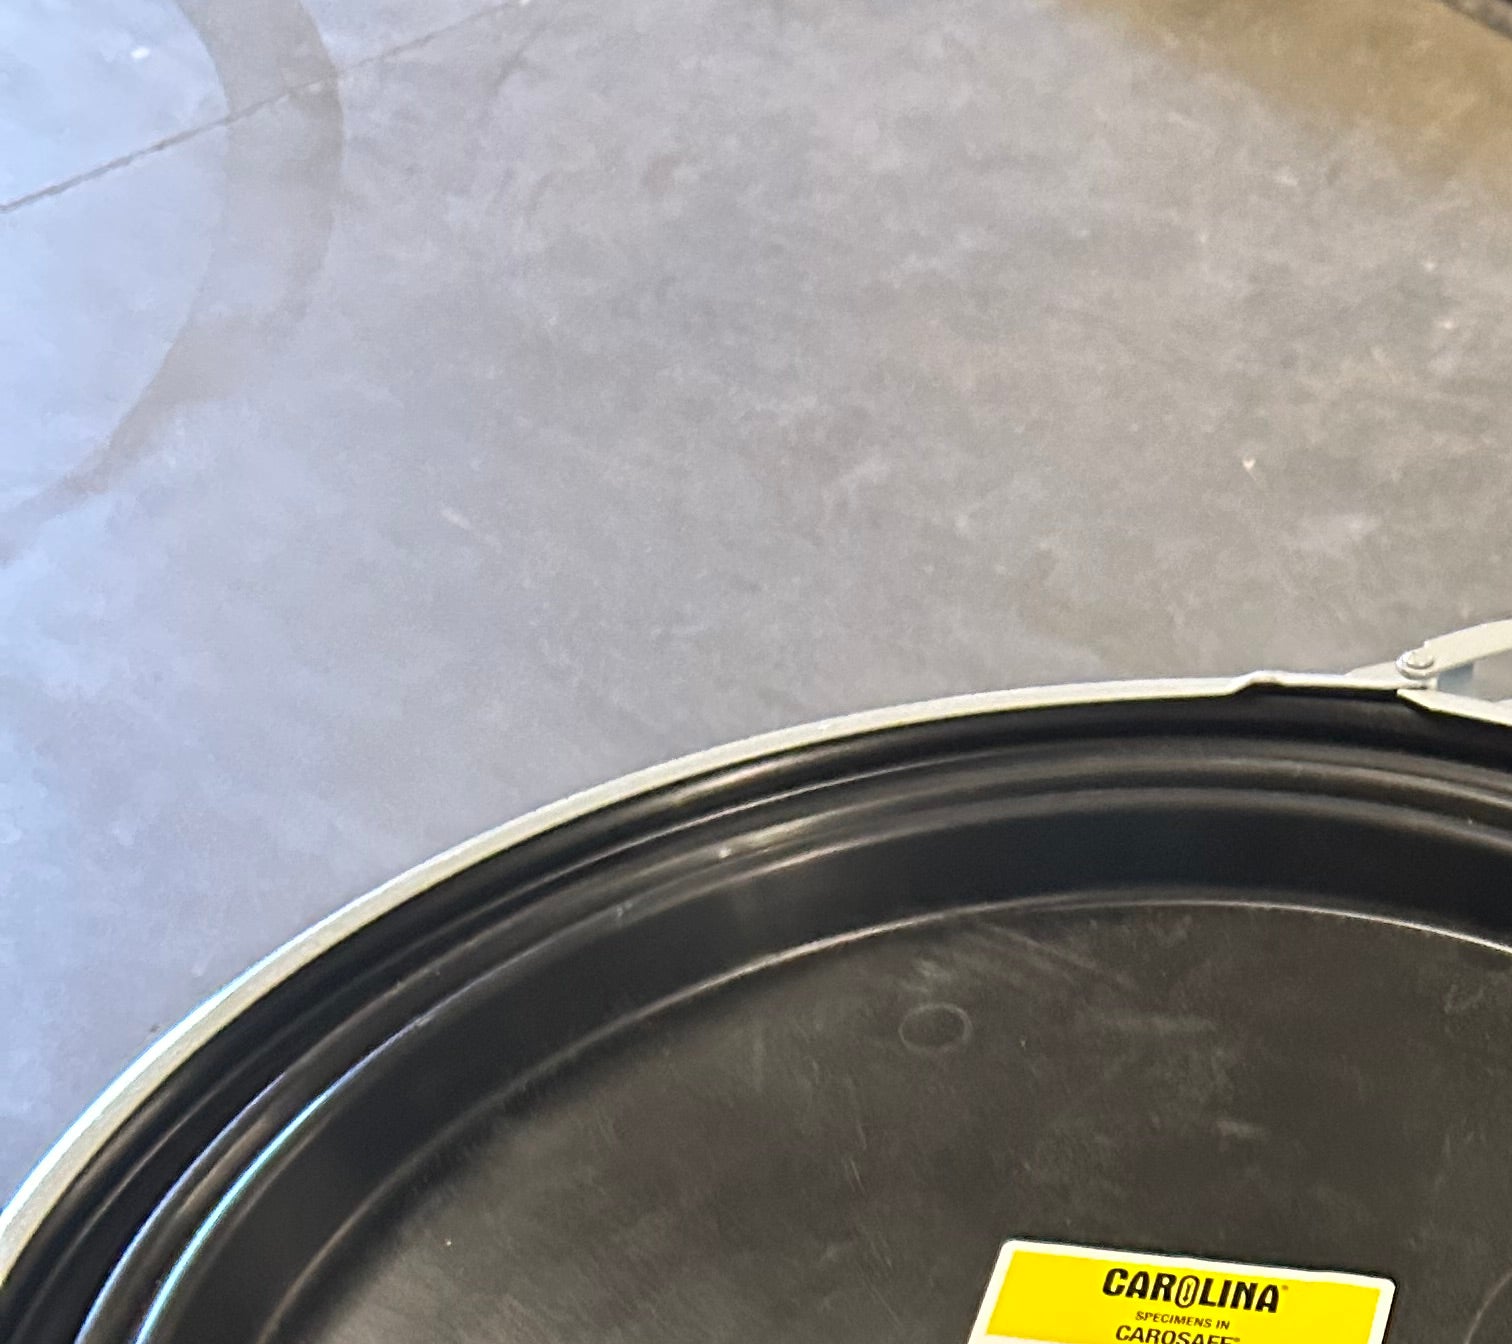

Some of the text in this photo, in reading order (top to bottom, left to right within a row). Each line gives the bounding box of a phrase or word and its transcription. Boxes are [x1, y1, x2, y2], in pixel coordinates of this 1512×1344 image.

[1102, 1267, 1280, 1314] CAROLINA
[1135, 1310, 1230, 1330] SPECIMENS IN
